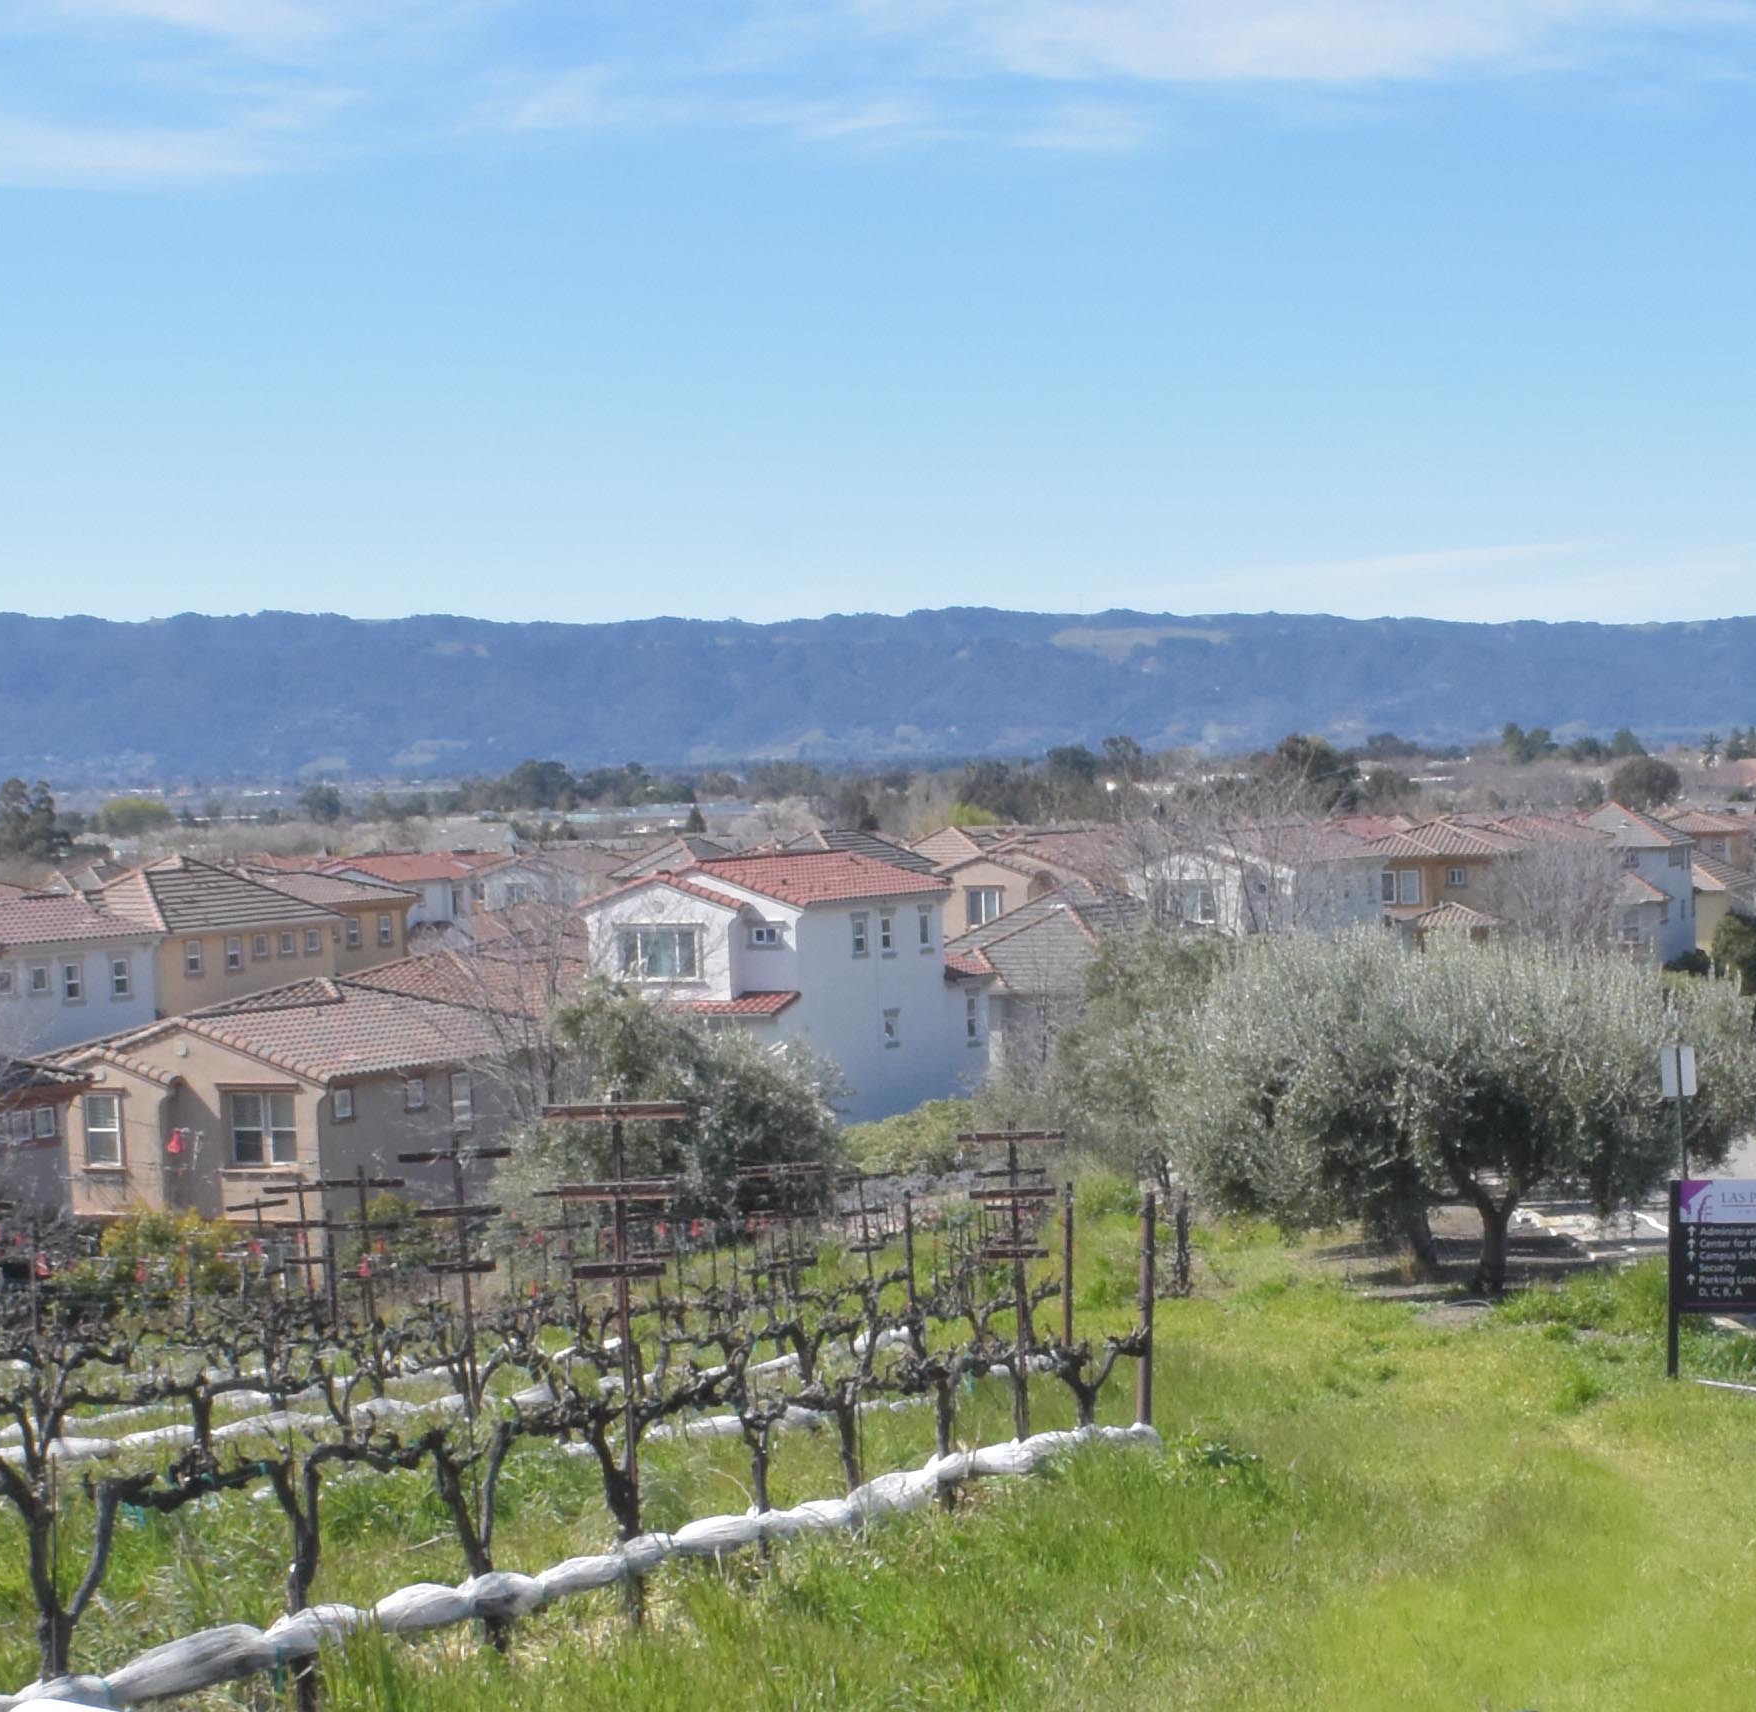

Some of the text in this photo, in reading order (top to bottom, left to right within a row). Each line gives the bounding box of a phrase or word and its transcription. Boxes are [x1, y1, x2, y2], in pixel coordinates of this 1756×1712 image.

[1721, 1192, 1745, 1203] LAS
[1699, 1239, 1731, 1249] Center
[1733, 1239, 1747, 1248] for
[1699, 1251, 1736, 1262] Campus
[1699, 1263, 1737, 1273] Security
[1698, 1275, 1756, 1286] Parking Lots
[1734, 1287, 1743, 1296] A
